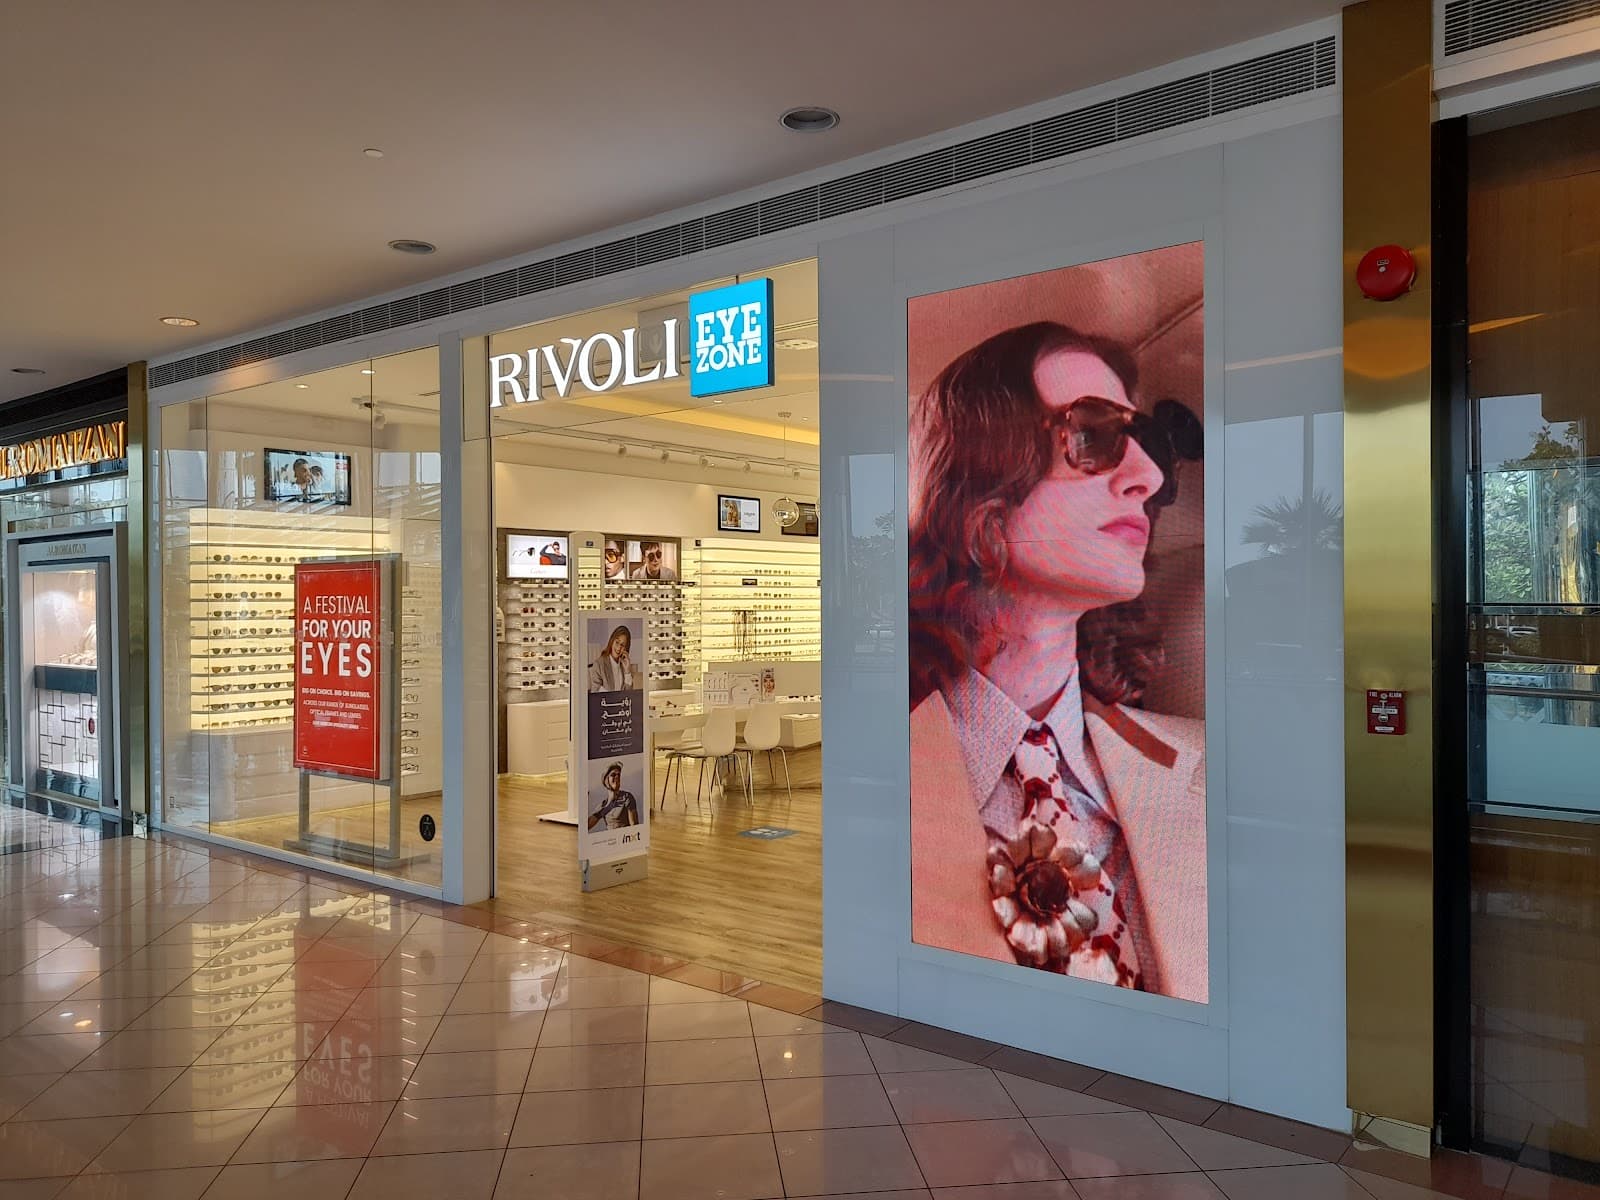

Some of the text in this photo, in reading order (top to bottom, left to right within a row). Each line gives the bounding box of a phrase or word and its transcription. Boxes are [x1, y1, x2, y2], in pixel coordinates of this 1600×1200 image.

[695, 302, 762, 348] EYE
[489, 318, 680, 408] RIVOLI
[696, 338, 762, 374] ZONE
[303, 595, 371, 614] A FESTIVAL
[302, 619, 371, 639] FOR YOUR
[301, 641, 372, 678] EYES
